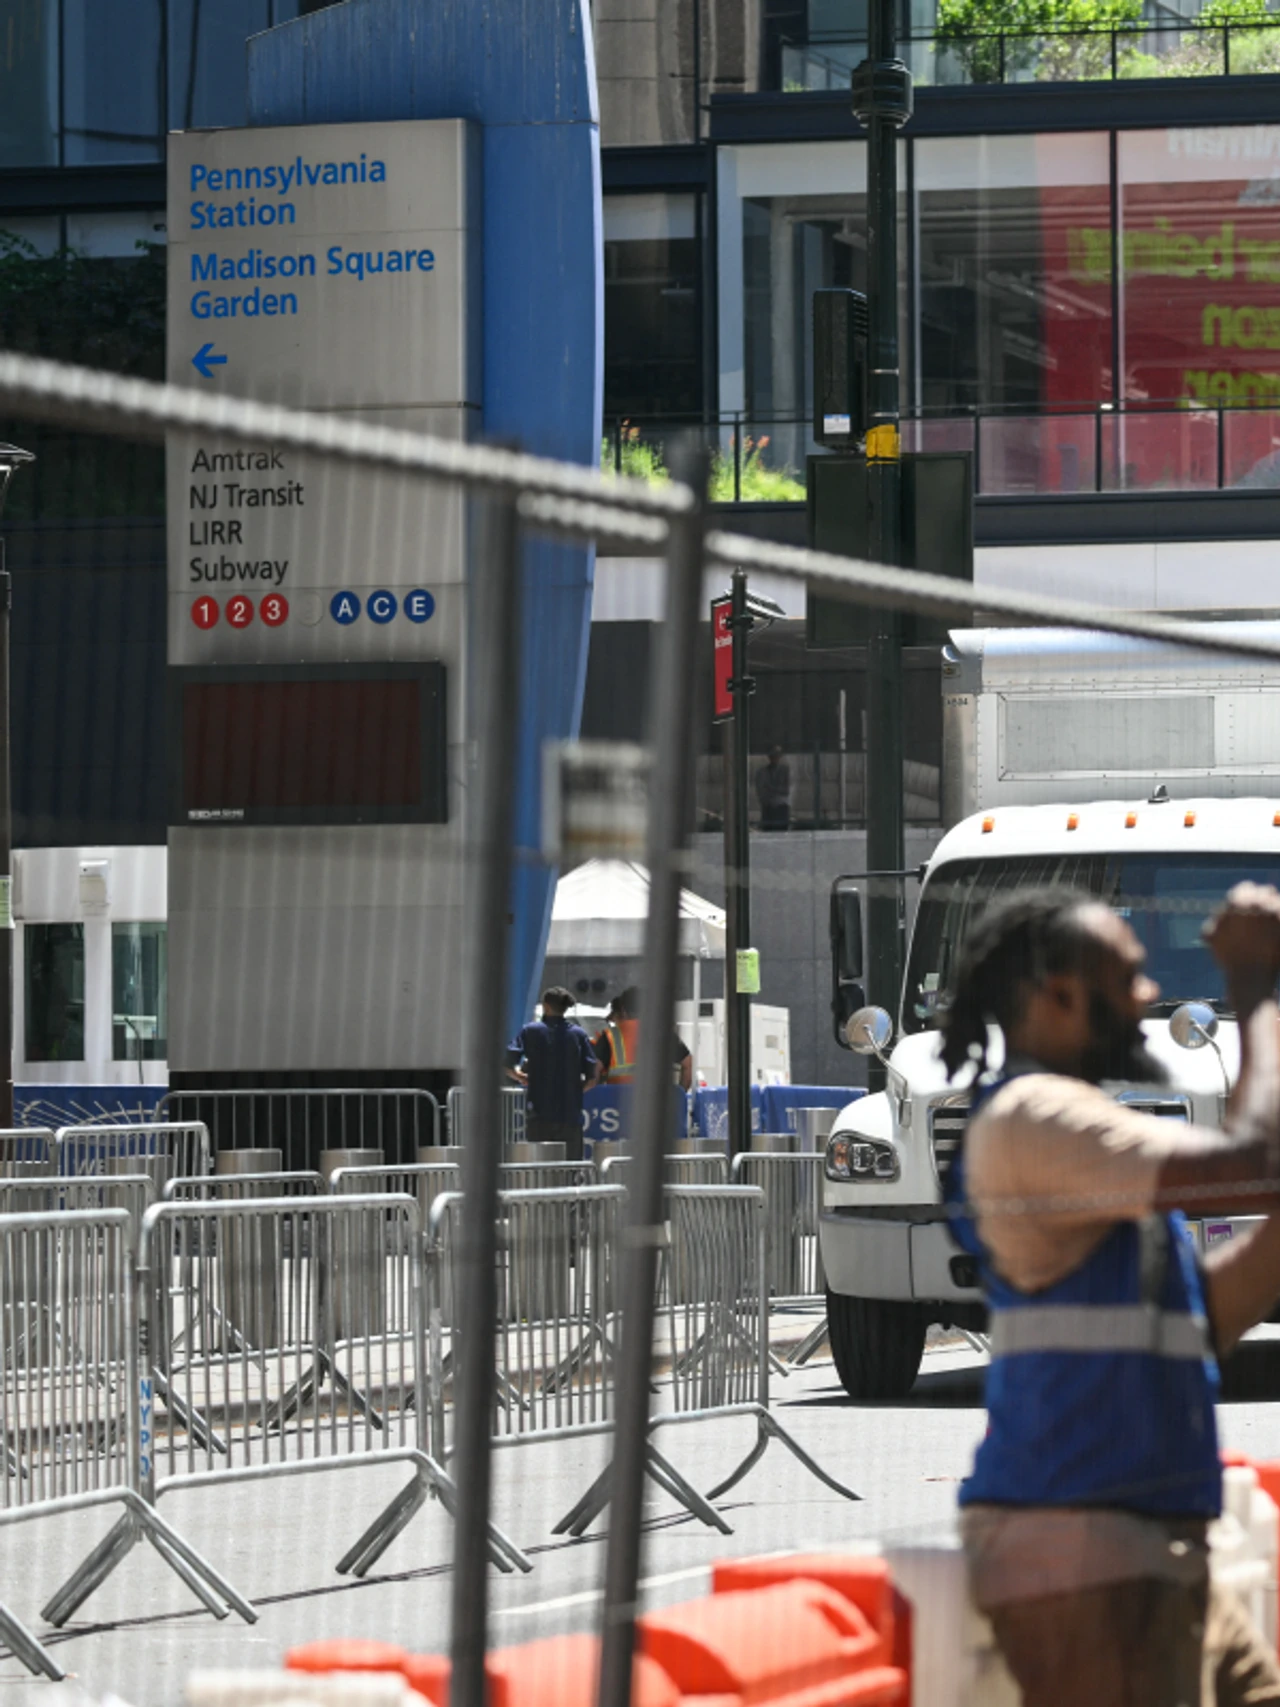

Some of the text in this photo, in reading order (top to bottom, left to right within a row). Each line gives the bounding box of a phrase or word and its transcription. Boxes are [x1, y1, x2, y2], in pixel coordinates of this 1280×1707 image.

[190, 153, 386, 195] Pennsylvania
[190, 199, 296, 230] Station
[191, 246, 435, 283] Madison Square
[190, 287, 298, 320] Garden
[191, 447, 284, 473] Amtrak
[190, 480, 305, 510] NJ Transit
[190, 520, 243, 546] LIRR
[190, 555, 289, 586] Subway
[199, 596, 426, 623] 1 2 3 A C E
[140, 1379, 151, 1477] NYPD
